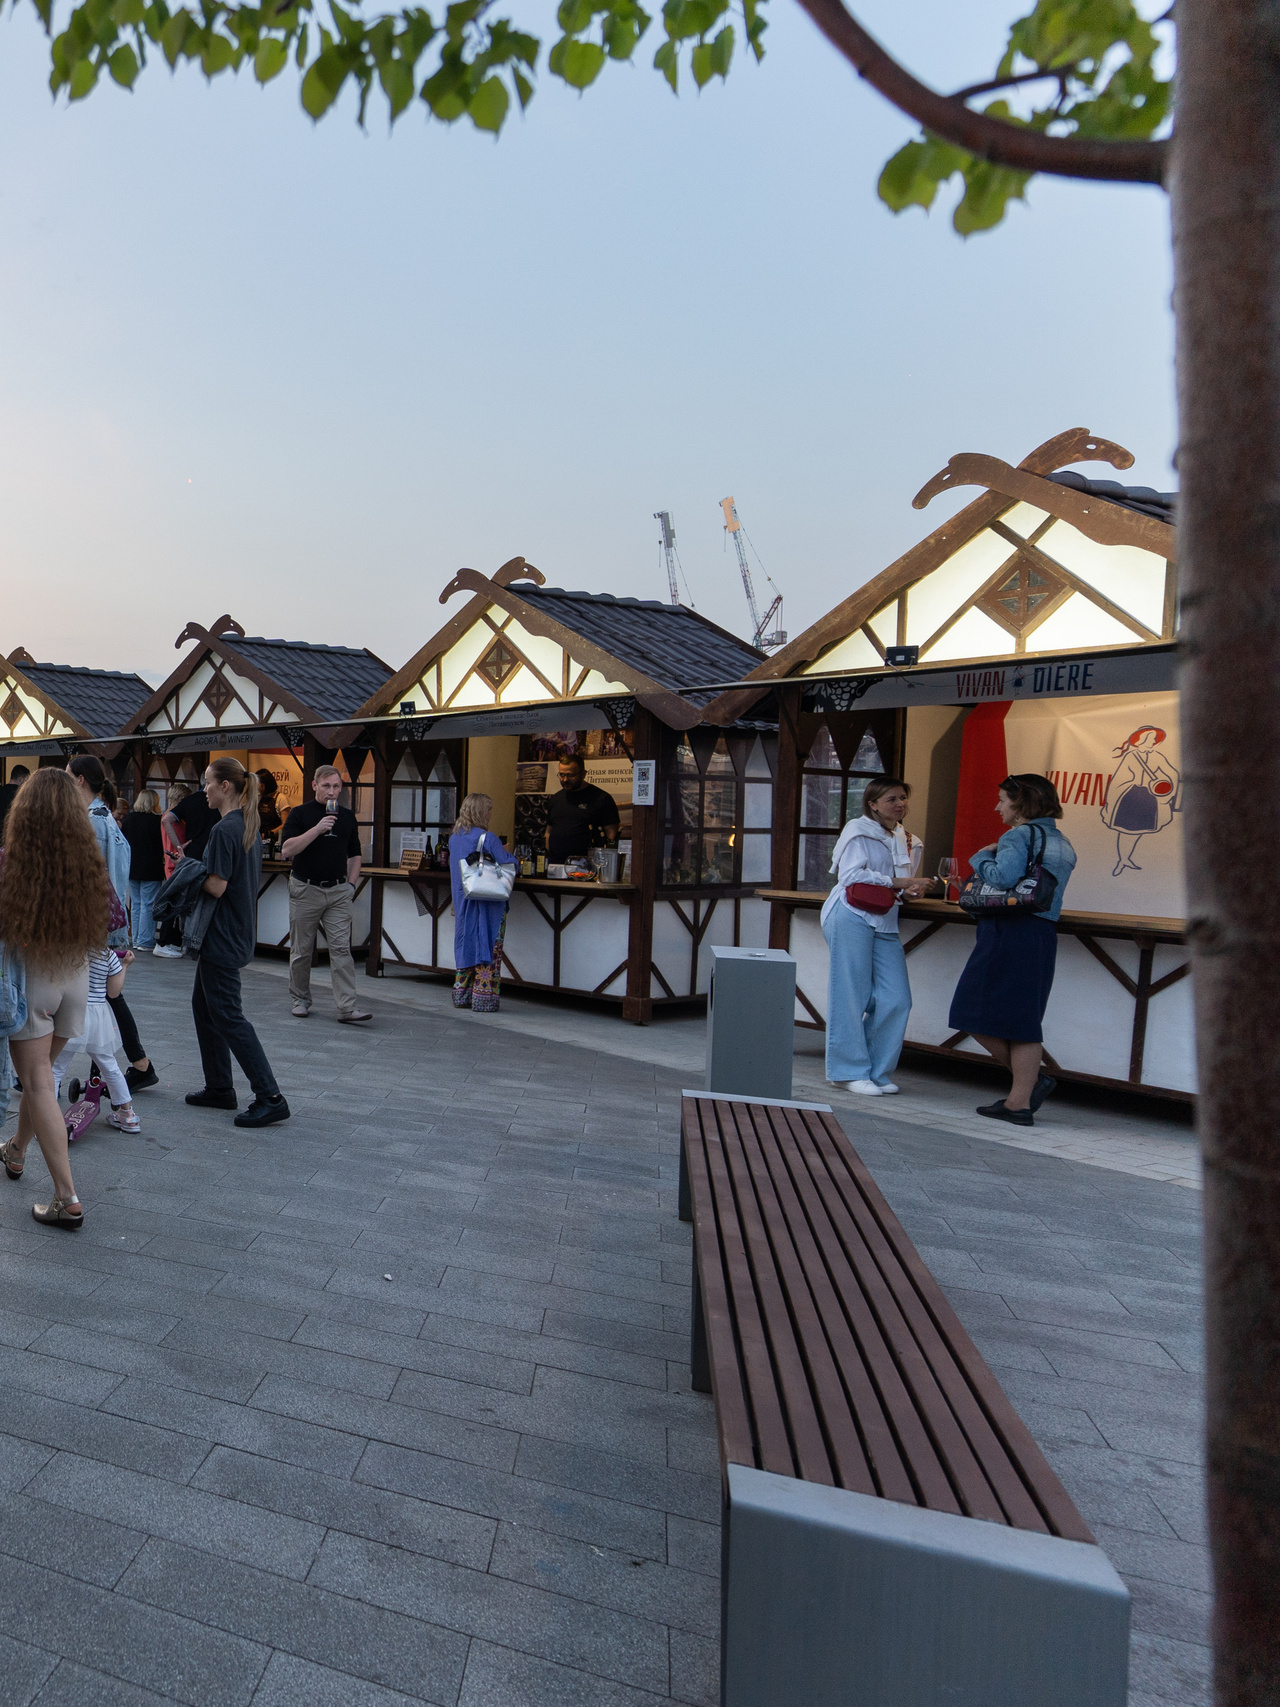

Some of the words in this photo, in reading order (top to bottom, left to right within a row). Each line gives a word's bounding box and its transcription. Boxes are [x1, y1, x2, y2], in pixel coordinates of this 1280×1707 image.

[956, 670, 1006, 698] VIVAN
[194, 735, 219, 746] AGORA
[227, 734, 255, 744] WINERY
[271, 769, 290, 782] ОБУЙ
[587, 768, 607, 776] йная
